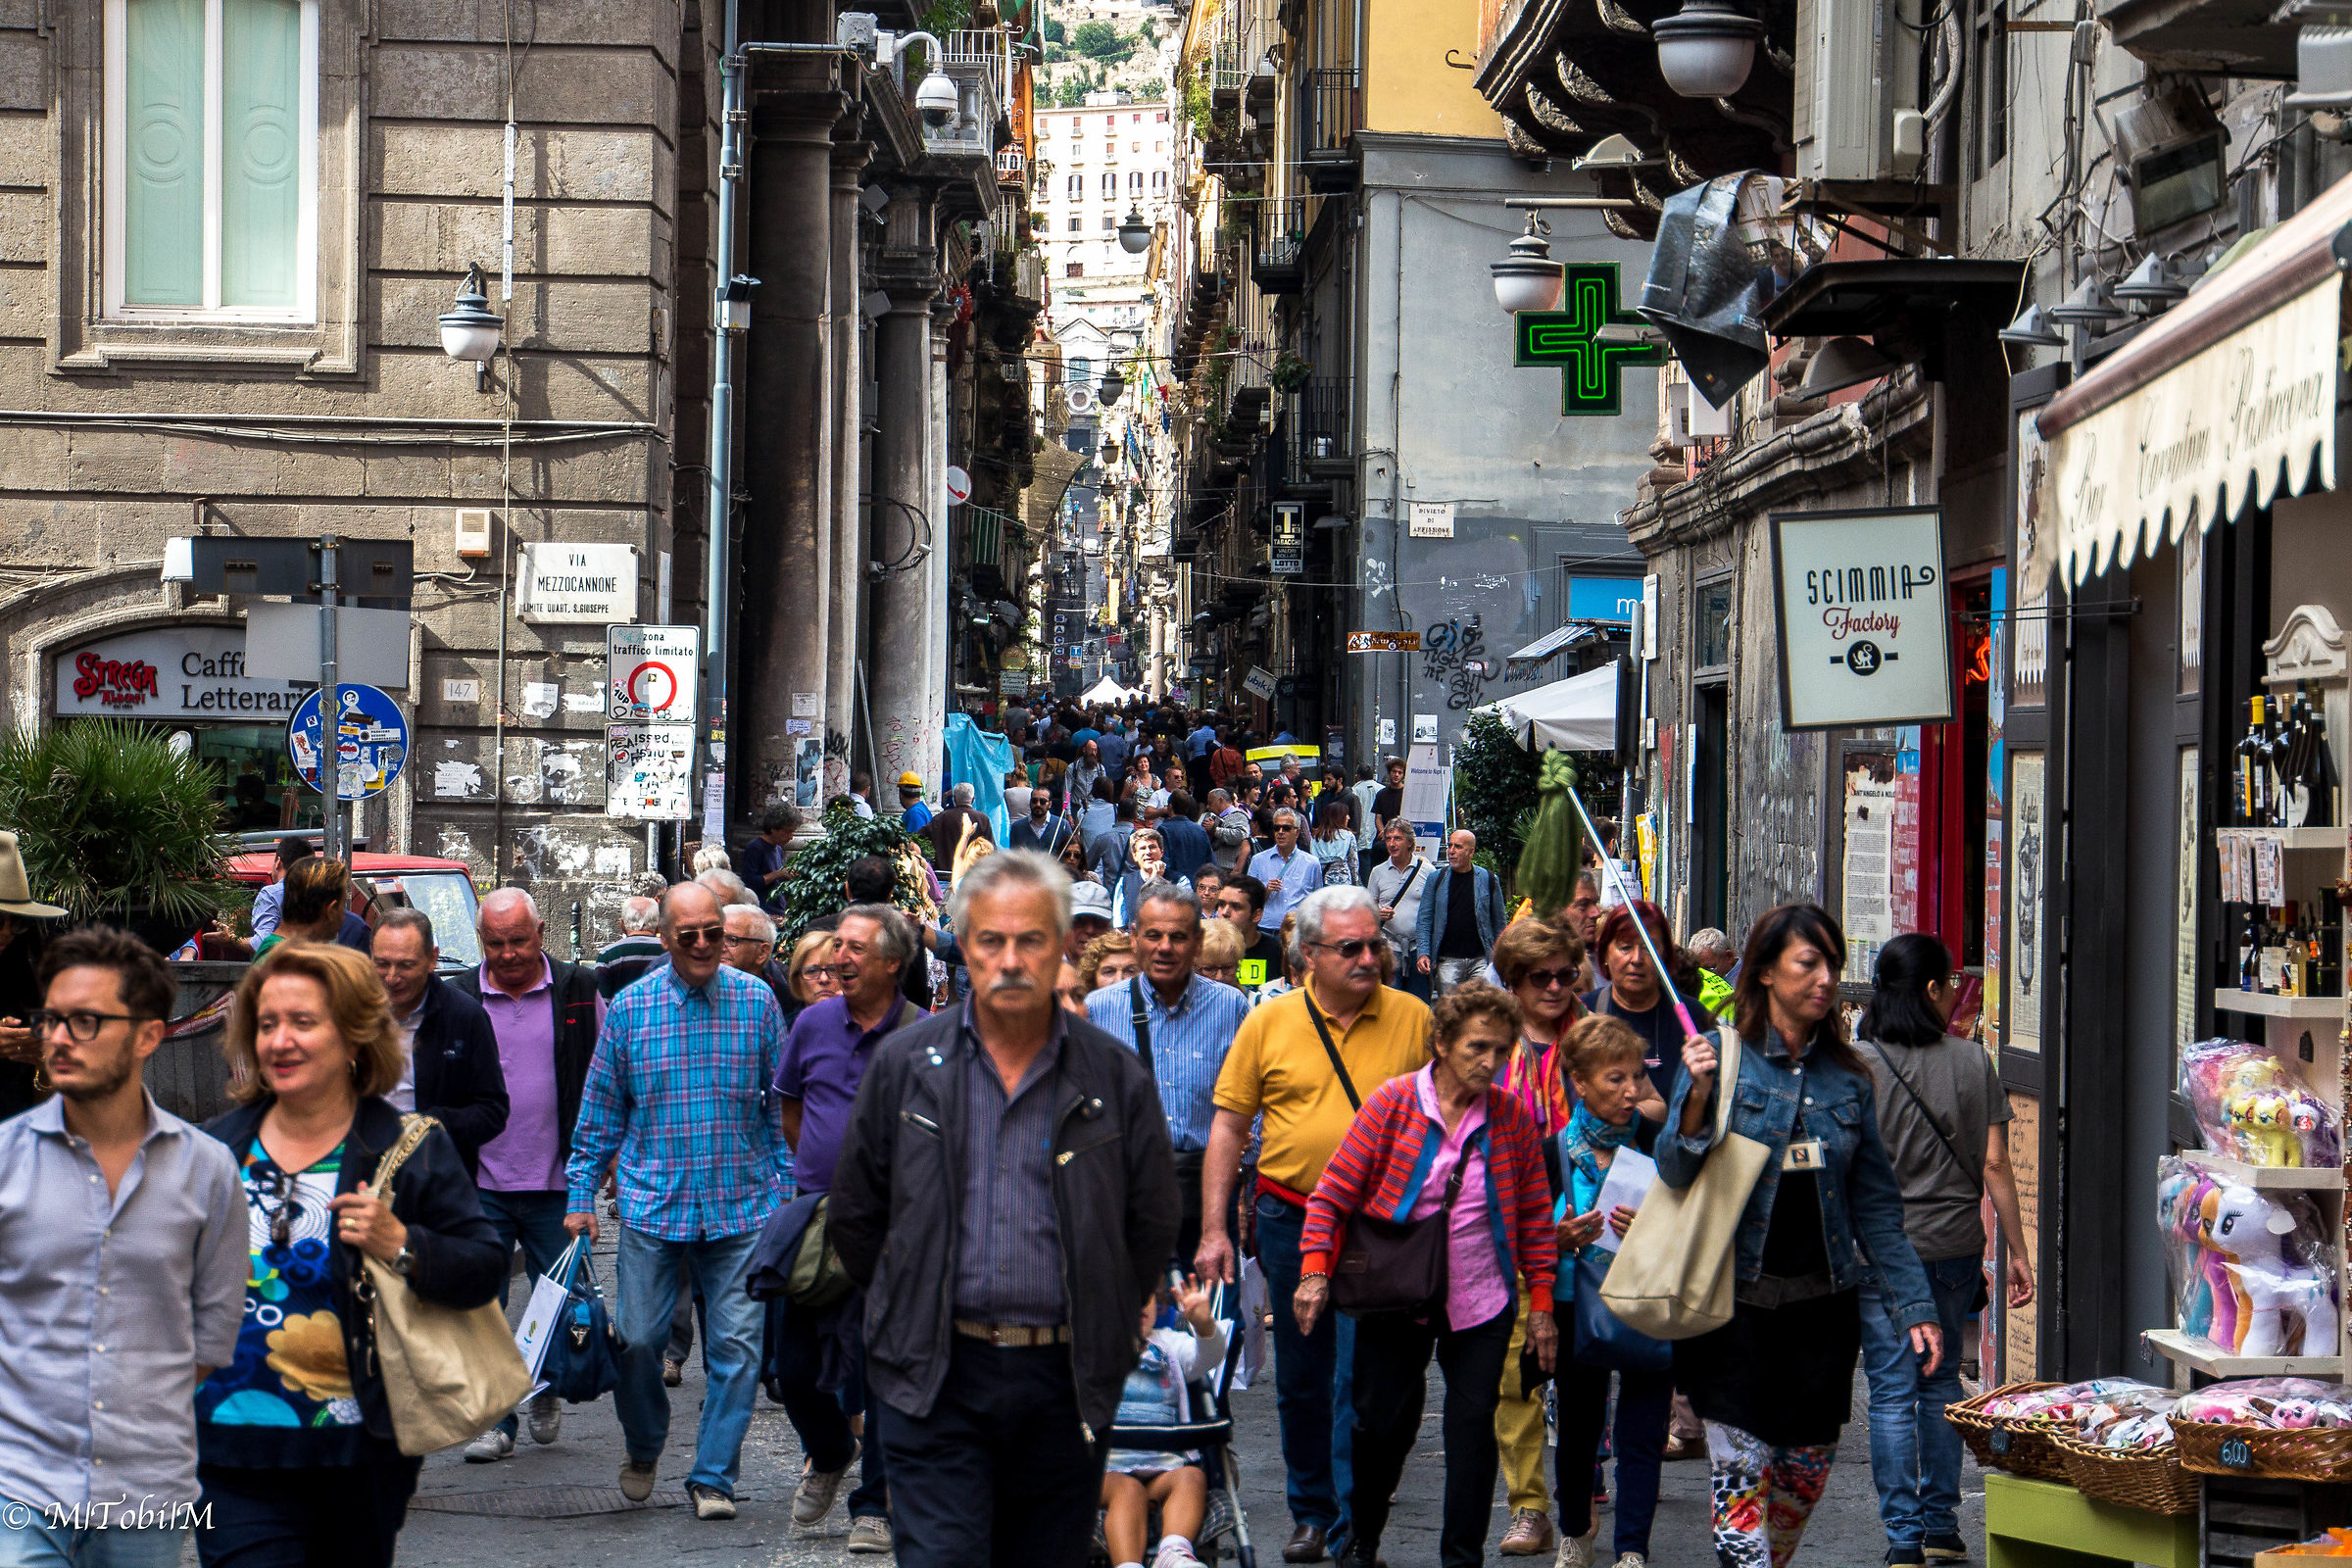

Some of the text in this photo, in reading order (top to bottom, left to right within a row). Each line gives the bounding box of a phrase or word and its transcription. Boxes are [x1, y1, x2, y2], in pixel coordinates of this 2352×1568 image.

[568, 554, 587, 566] VIA
[537, 576, 617, 593] MEZZOCANNONE
[1807, 564, 1936, 605] SCIMMIA
[522, 603, 544, 612] LIMITE
[1823, 607, 1900, 640] Factory
[643, 633, 664, 642] zona
[613, 645, 694, 657] traffico limitato
[73, 652, 160, 703] STREGA
[447, 683, 472, 699] 147
[613, 689, 631, 705] 1UP
[2222, 1441, 2247, 1465] 6,00
